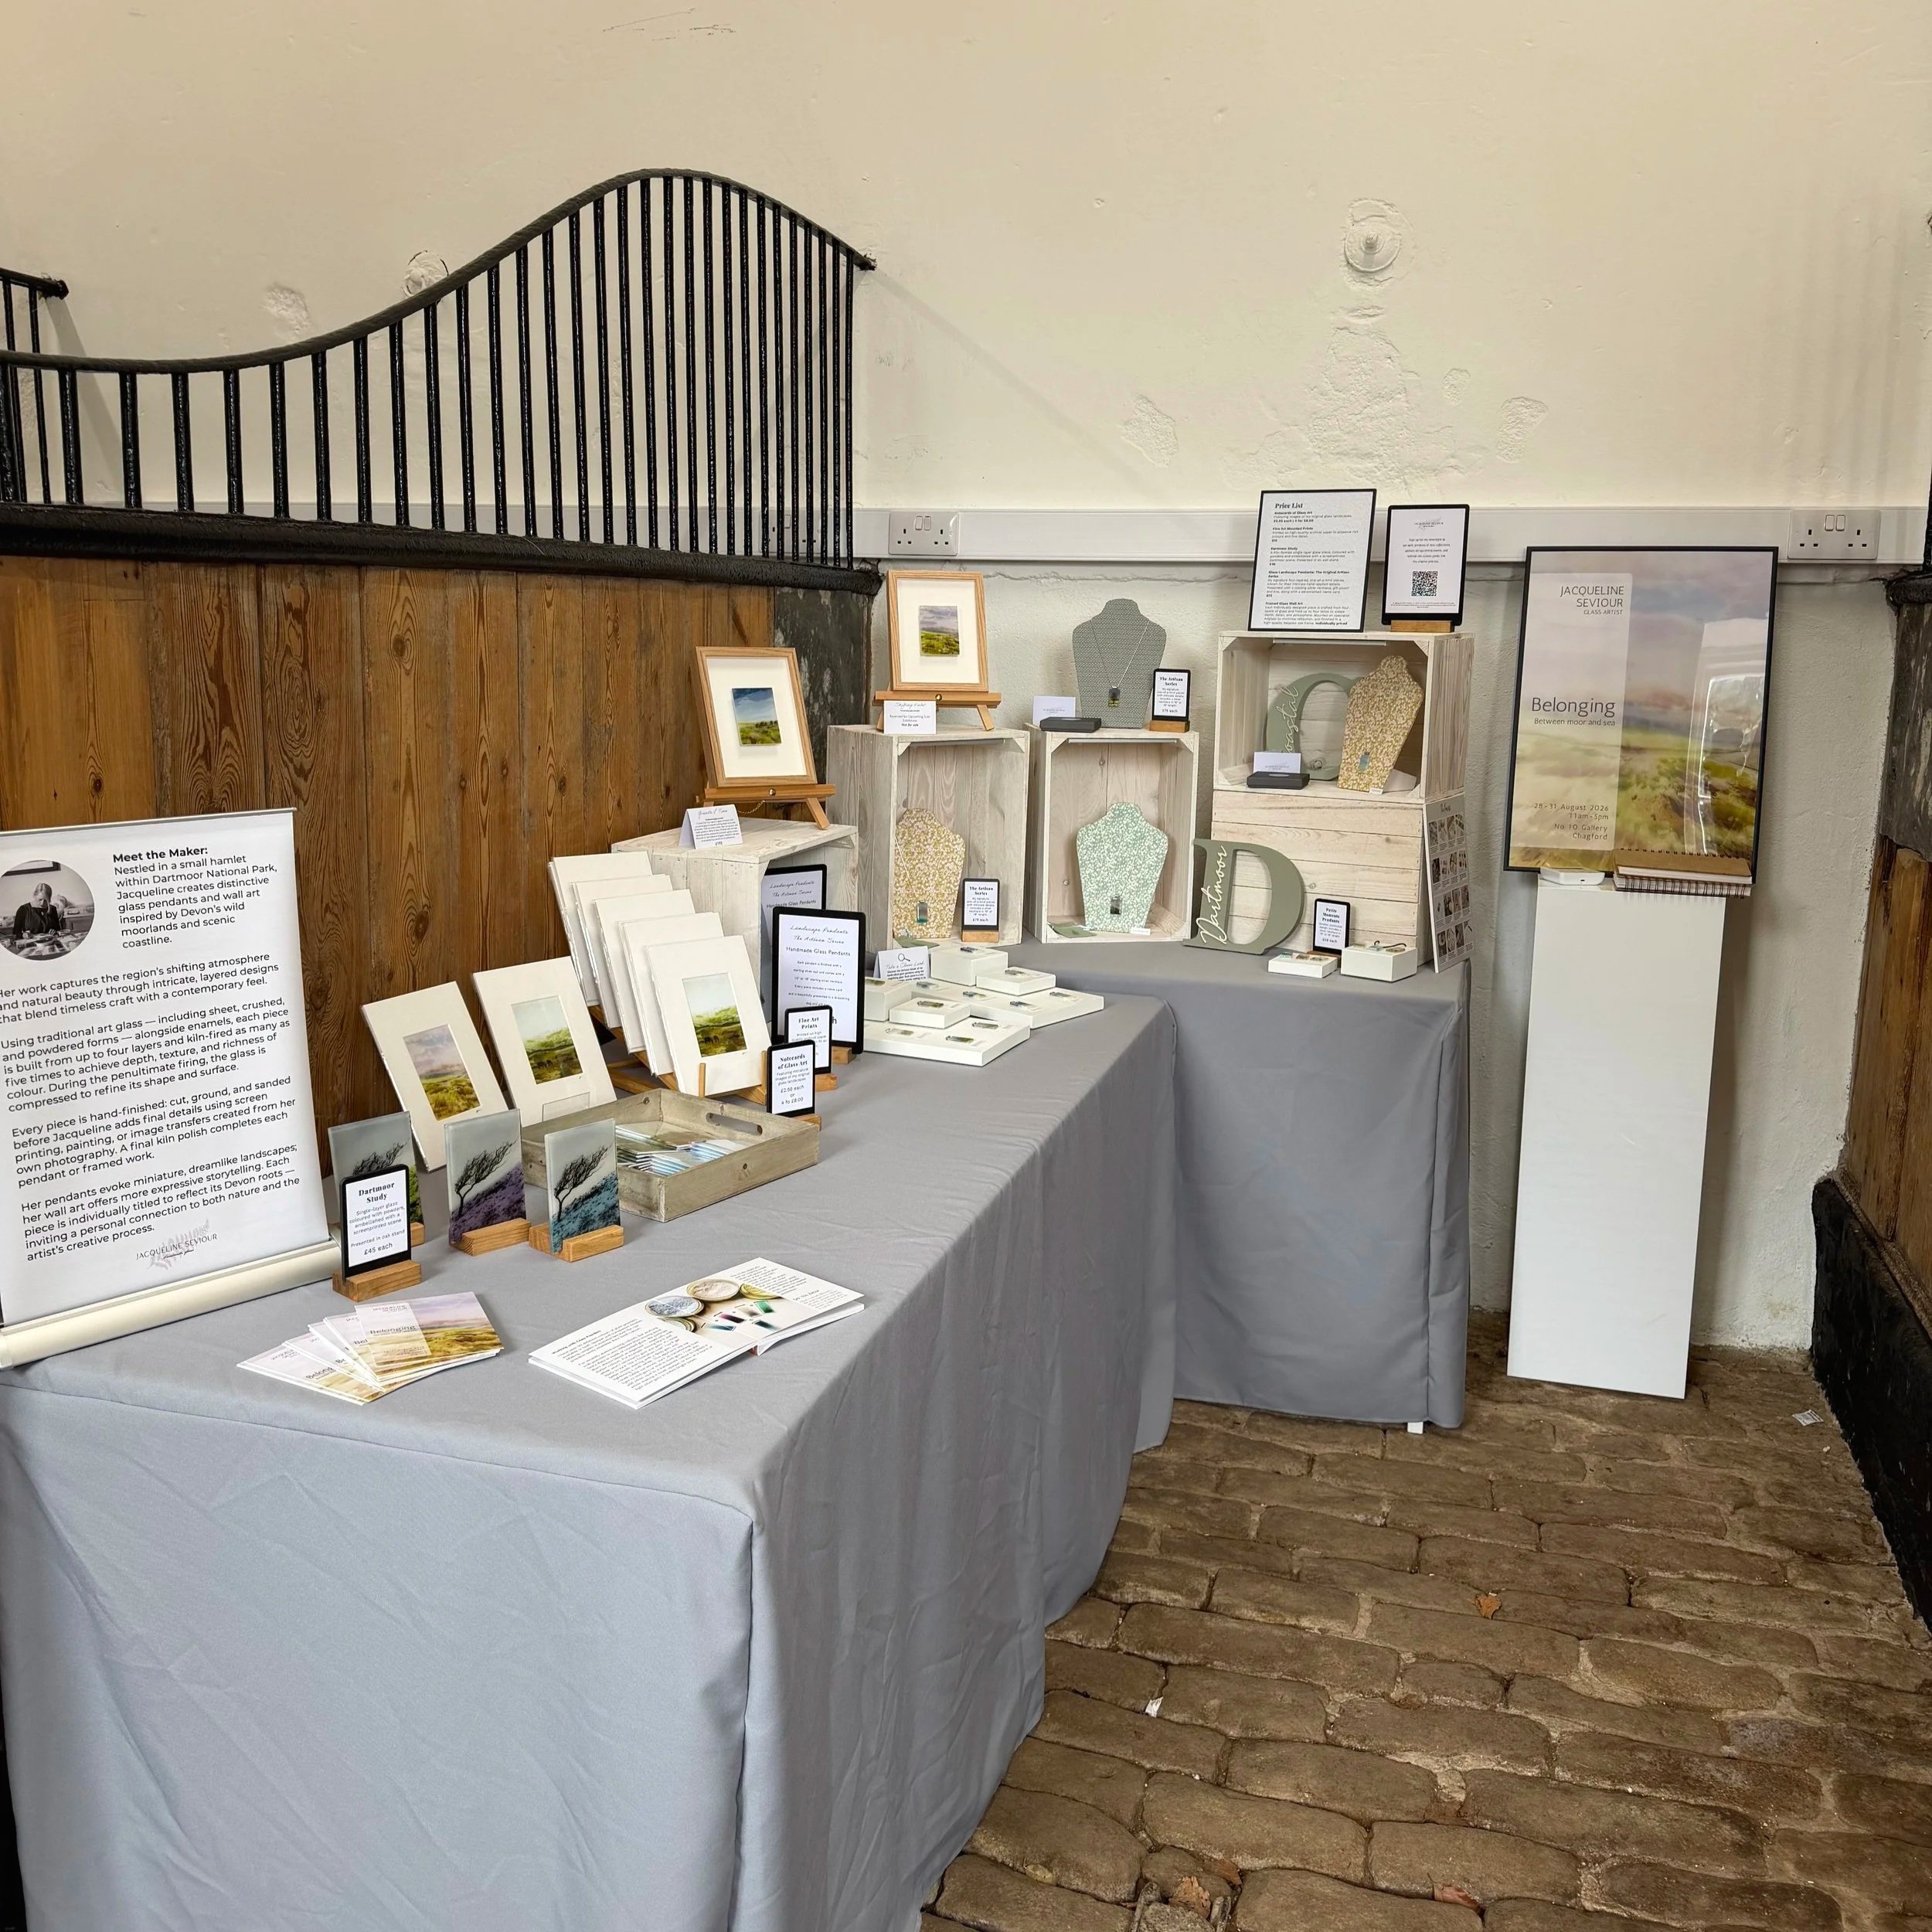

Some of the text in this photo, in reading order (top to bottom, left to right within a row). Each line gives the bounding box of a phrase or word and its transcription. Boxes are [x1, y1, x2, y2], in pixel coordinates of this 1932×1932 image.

[1560, 586, 1624, 597] JACQUELINE
[1577, 598, 1624, 607] SEVIOUR
[1532, 697, 1616, 718] Belonging
[1275, 685, 1299, 754] oastal
[1573, 832, 1607, 841] Chagford
[1581, 824, 1607, 833] Gallery
[112, 846, 209, 864] Meet the Maker:
[114, 854, 247, 876] Nestled in a small hamlet
[114, 862, 278, 888] within Dartmoor National Park,
[116, 876, 270, 901] Jacqueline creates distinctive
[1196, 845, 1227, 944] Dartmoor
[117, 889, 261, 915] glass pendants and wall art
[119, 900, 246, 925] inspired by Devon's wild
[121, 914, 236, 937] moorlands and scenic
[121, 935, 173, 949] coastline.
[17, 982, 49, 996] work
[49, 977, 100, 992] captures
[100, 973, 121, 985] the
[121, 966, 165, 982] region's
[165, 961, 206, 975] shifting
[207, 953, 270, 969] atmosphere
[21, 992, 63, 1009] natural
[63, 988, 104, 1002] beauty
[104, 980, 151, 996] through
[151, 975, 199, 989] intricate,
[199, 968, 238, 983] layered
[239, 964, 280, 977] designs
[24, 1005, 58, 1021] blend
[59, 1000, 107, 1015] timeless
[108, 995, 135, 1008] craft
[135, 991, 161, 1004] with
[162, 992, 169, 1000] a
[171, 980, 245, 998] contemporary
[245, 975, 268, 988] feel.
[780, 1053, 805, 1063] Notecards
[358, 1182, 395, 1196] Dartmoor
[366, 1192, 388, 1204] Study
[349, 1215, 371, 1224] coloured
[355, 1217, 384, 1229] embellished
[353, 1223, 386, 1236] screenprinted
[136, 1243, 182, 1260] JACQUELINE
[184, 1233, 218, 1247] SEVIOUR
[350, 1237, 375, 1247] Presented
[363, 1242, 393, 1256] £45 each
[369, 1325, 417, 1335] Belonging
